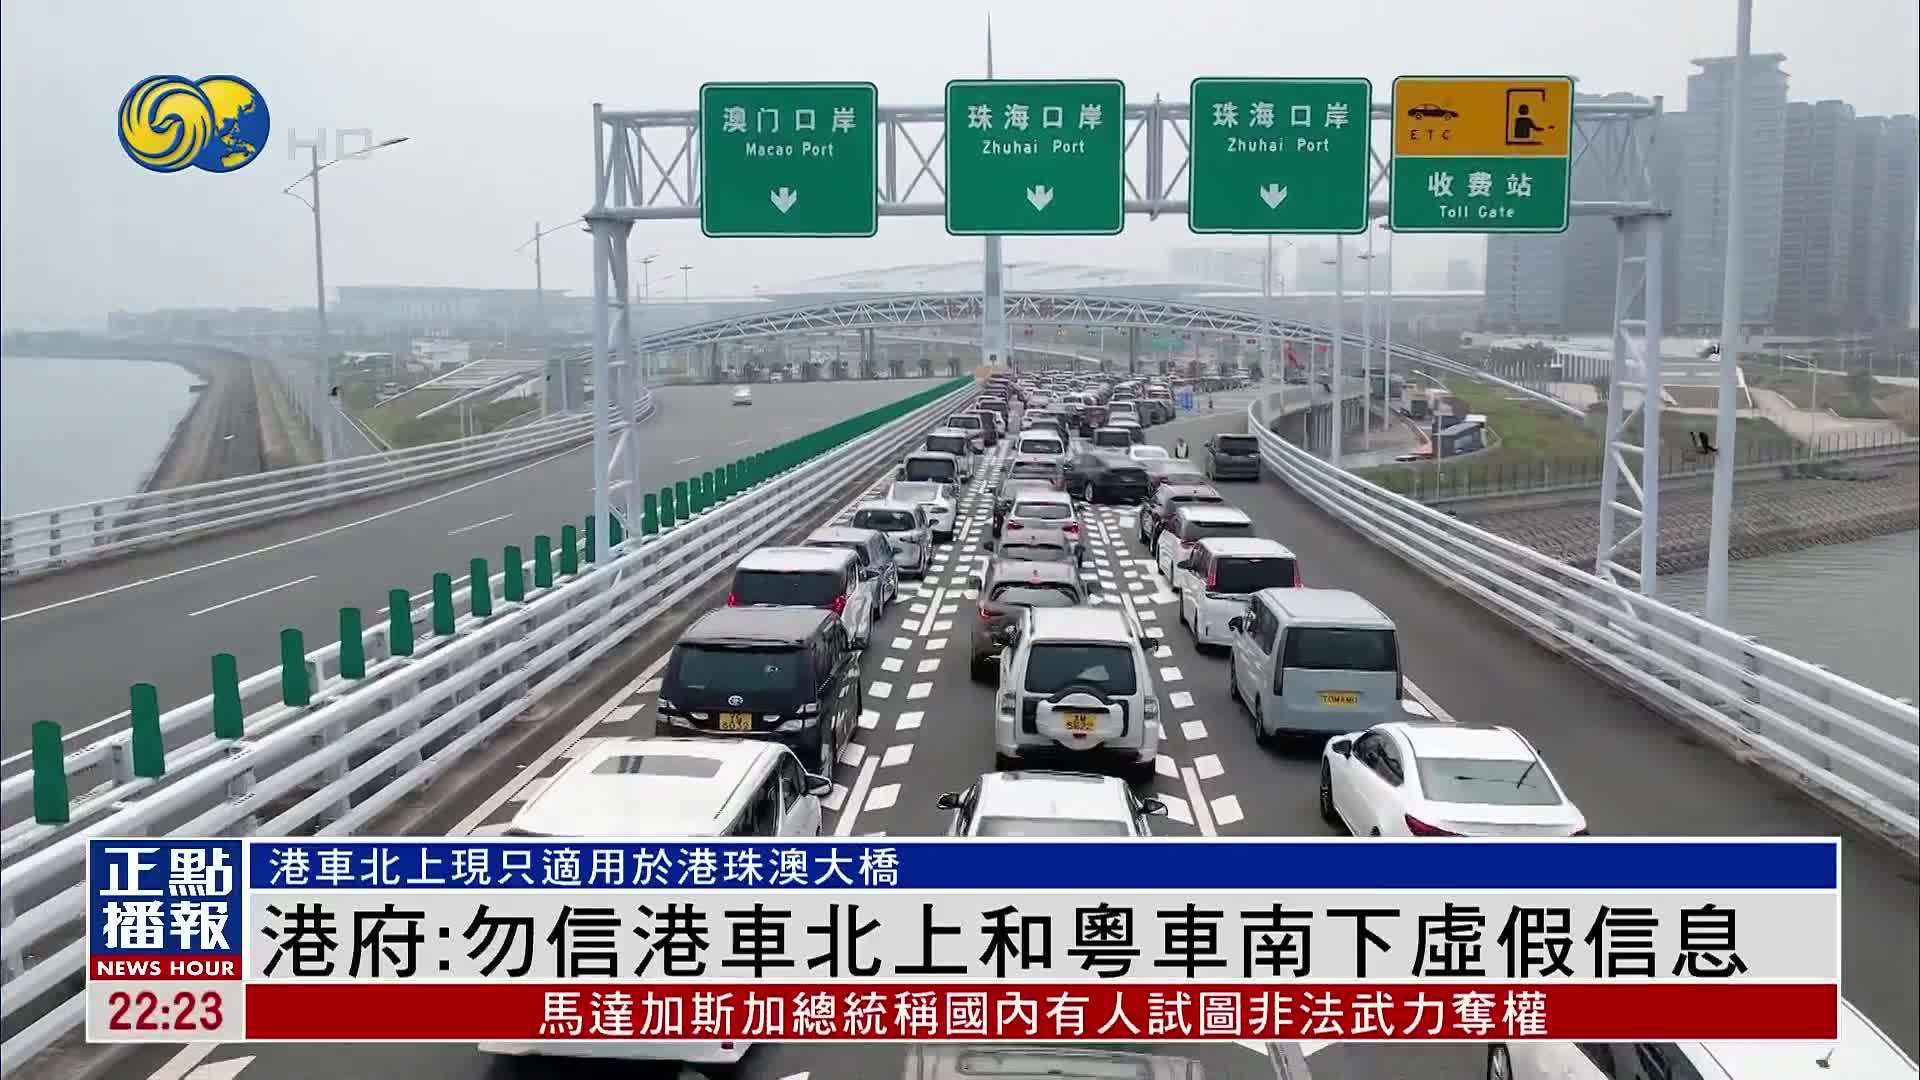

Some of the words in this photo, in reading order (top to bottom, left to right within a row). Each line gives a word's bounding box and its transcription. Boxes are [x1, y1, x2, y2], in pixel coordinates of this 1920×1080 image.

[724, 107, 855, 132] 澳门口岸
[967, 104, 1102, 131] 珠海口岸
[1213, 102, 1349, 129] 珠海口岸
[746, 143, 793, 156] Macao
[802, 142, 833, 157] Port
[982, 139, 1036, 153] Zhuhai
[1052, 139, 1084, 153] Port
[1227, 137, 1282, 151] Zhuhai
[1297, 137, 1329, 151] Port
[1429, 172, 1533, 197] 收费站
[1440, 205, 1468, 218] Toll
[1478, 205, 1514, 218] Gate
